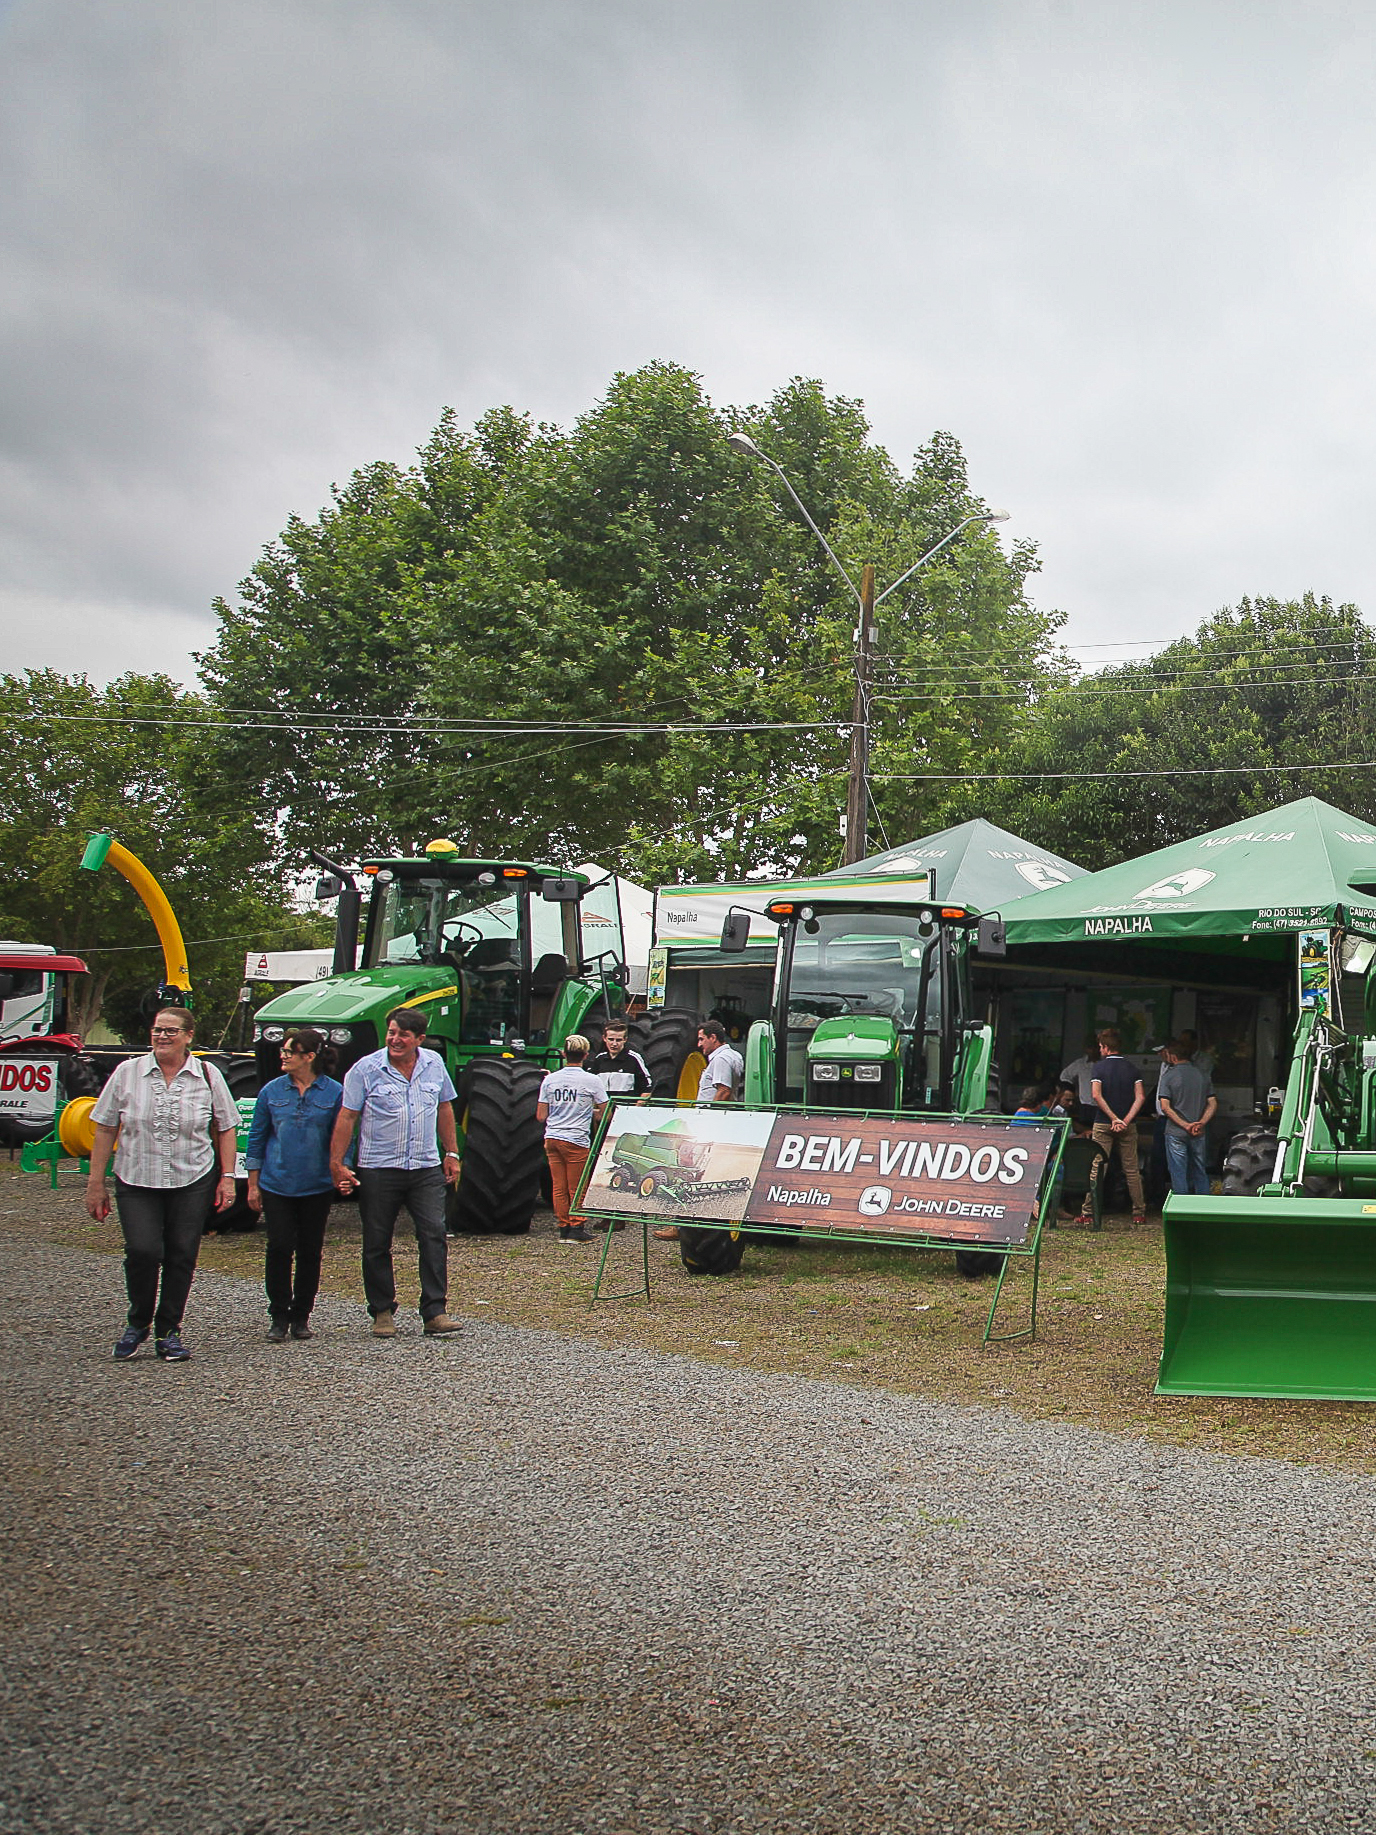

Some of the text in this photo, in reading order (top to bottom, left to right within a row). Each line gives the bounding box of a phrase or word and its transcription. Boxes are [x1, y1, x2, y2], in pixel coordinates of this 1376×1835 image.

[1198, 832, 1296, 848] NAPALHA
[667, 911, 698, 925] Napalha
[1258, 908, 1272, 918] RIO
[1274, 908, 1287, 917] DO
[1288, 907, 1304, 917] SUL
[1310, 907, 1322, 916] SC
[1084, 916, 1153, 936] NAPALHA
[1252, 920, 1273, 930] Fone:
[1273, 919, 1288, 930] (47)
[0, 1064, 53, 1092] DOS
[554, 1088, 577, 1102] OCN
[775, 1133, 1029, 1185] BEM-VINDOS
[766, 1185, 831, 1208] Napalha
[893, 1195, 1006, 1219] JOHN DEERE
